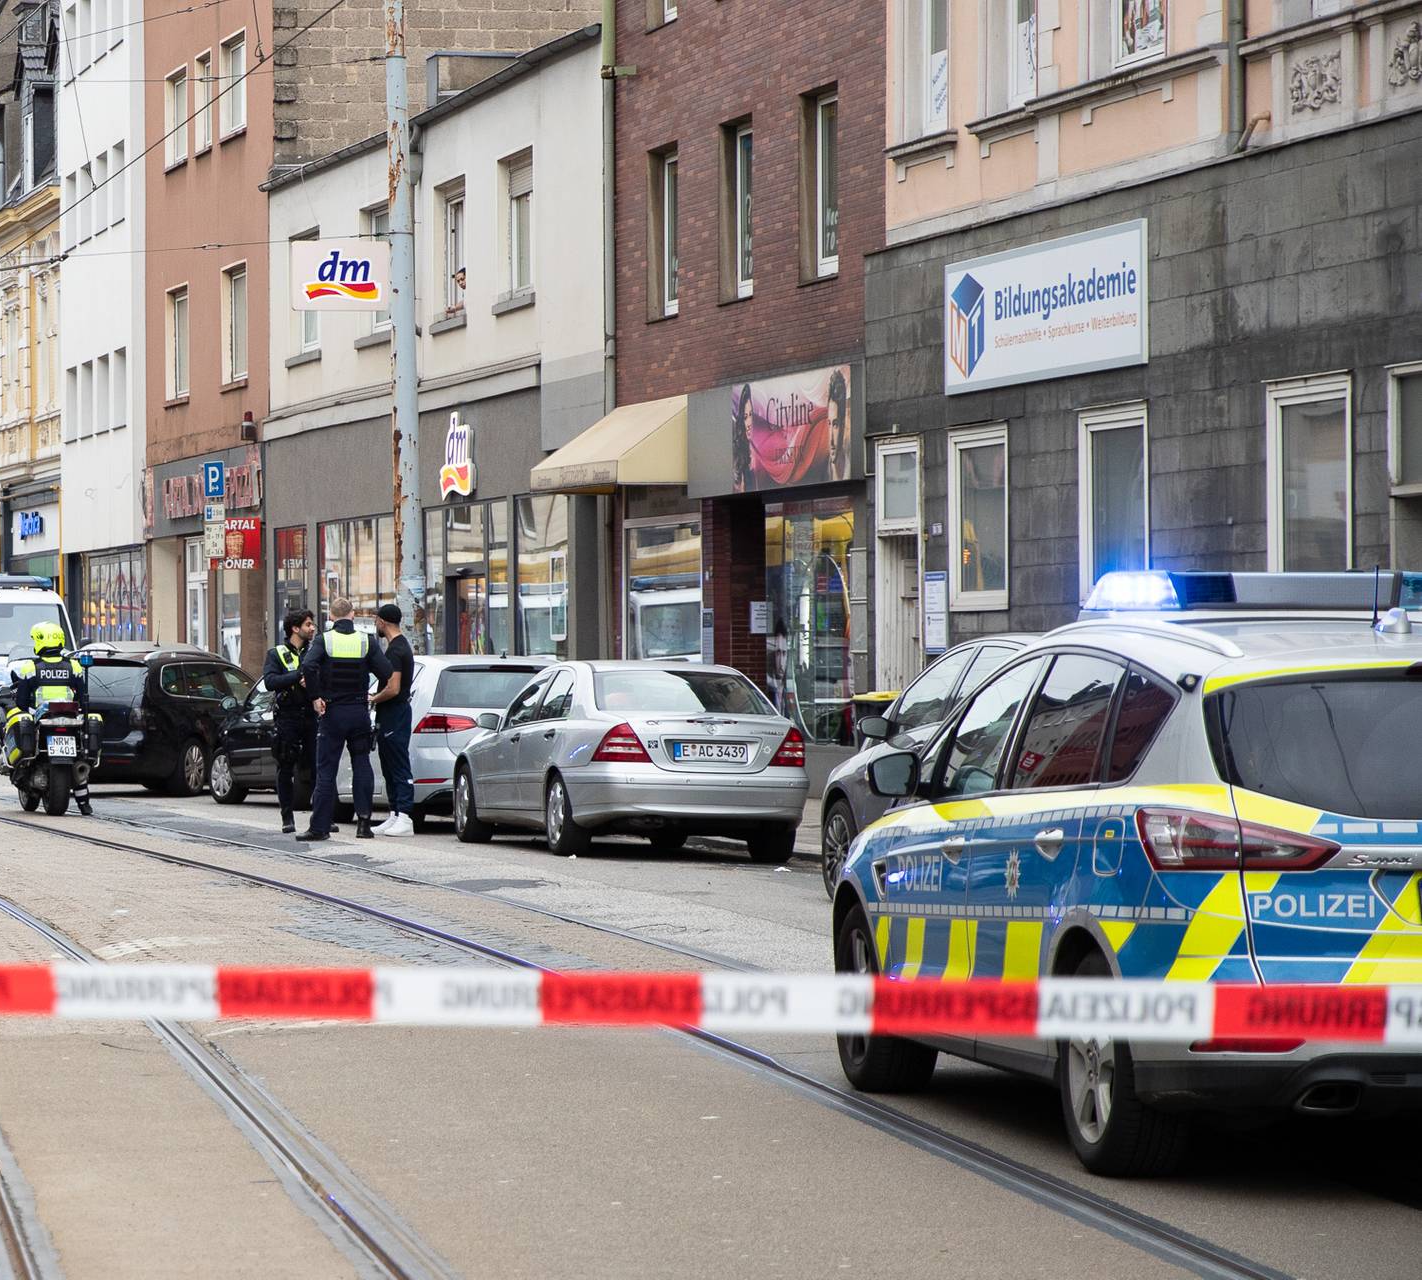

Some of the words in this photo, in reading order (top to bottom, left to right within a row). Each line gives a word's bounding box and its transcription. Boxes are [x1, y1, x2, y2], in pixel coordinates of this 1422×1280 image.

[317, 251, 371, 283] dm
[994, 261, 1137, 321] Bildungsakademie
[994, 327, 1042, 349] Schülernachhilfe
[1047, 321, 1085, 343] Sprachkurse
[1091, 311, 1137, 331] Weiterbildung
[766, 393, 814, 433] Cityline
[447, 417, 468, 466] dm
[224, 519, 256, 530] ARTAL
[223, 557, 255, 569] ÖNER
[40, 669, 70, 679] POLIZEI
[682, 744, 690, 757] E
[698, 744, 714, 758] AC
[716, 745, 746, 759] 3439
[896, 855, 944, 893] POLIZEI
[1252, 893, 1376, 919] POLIZEI
